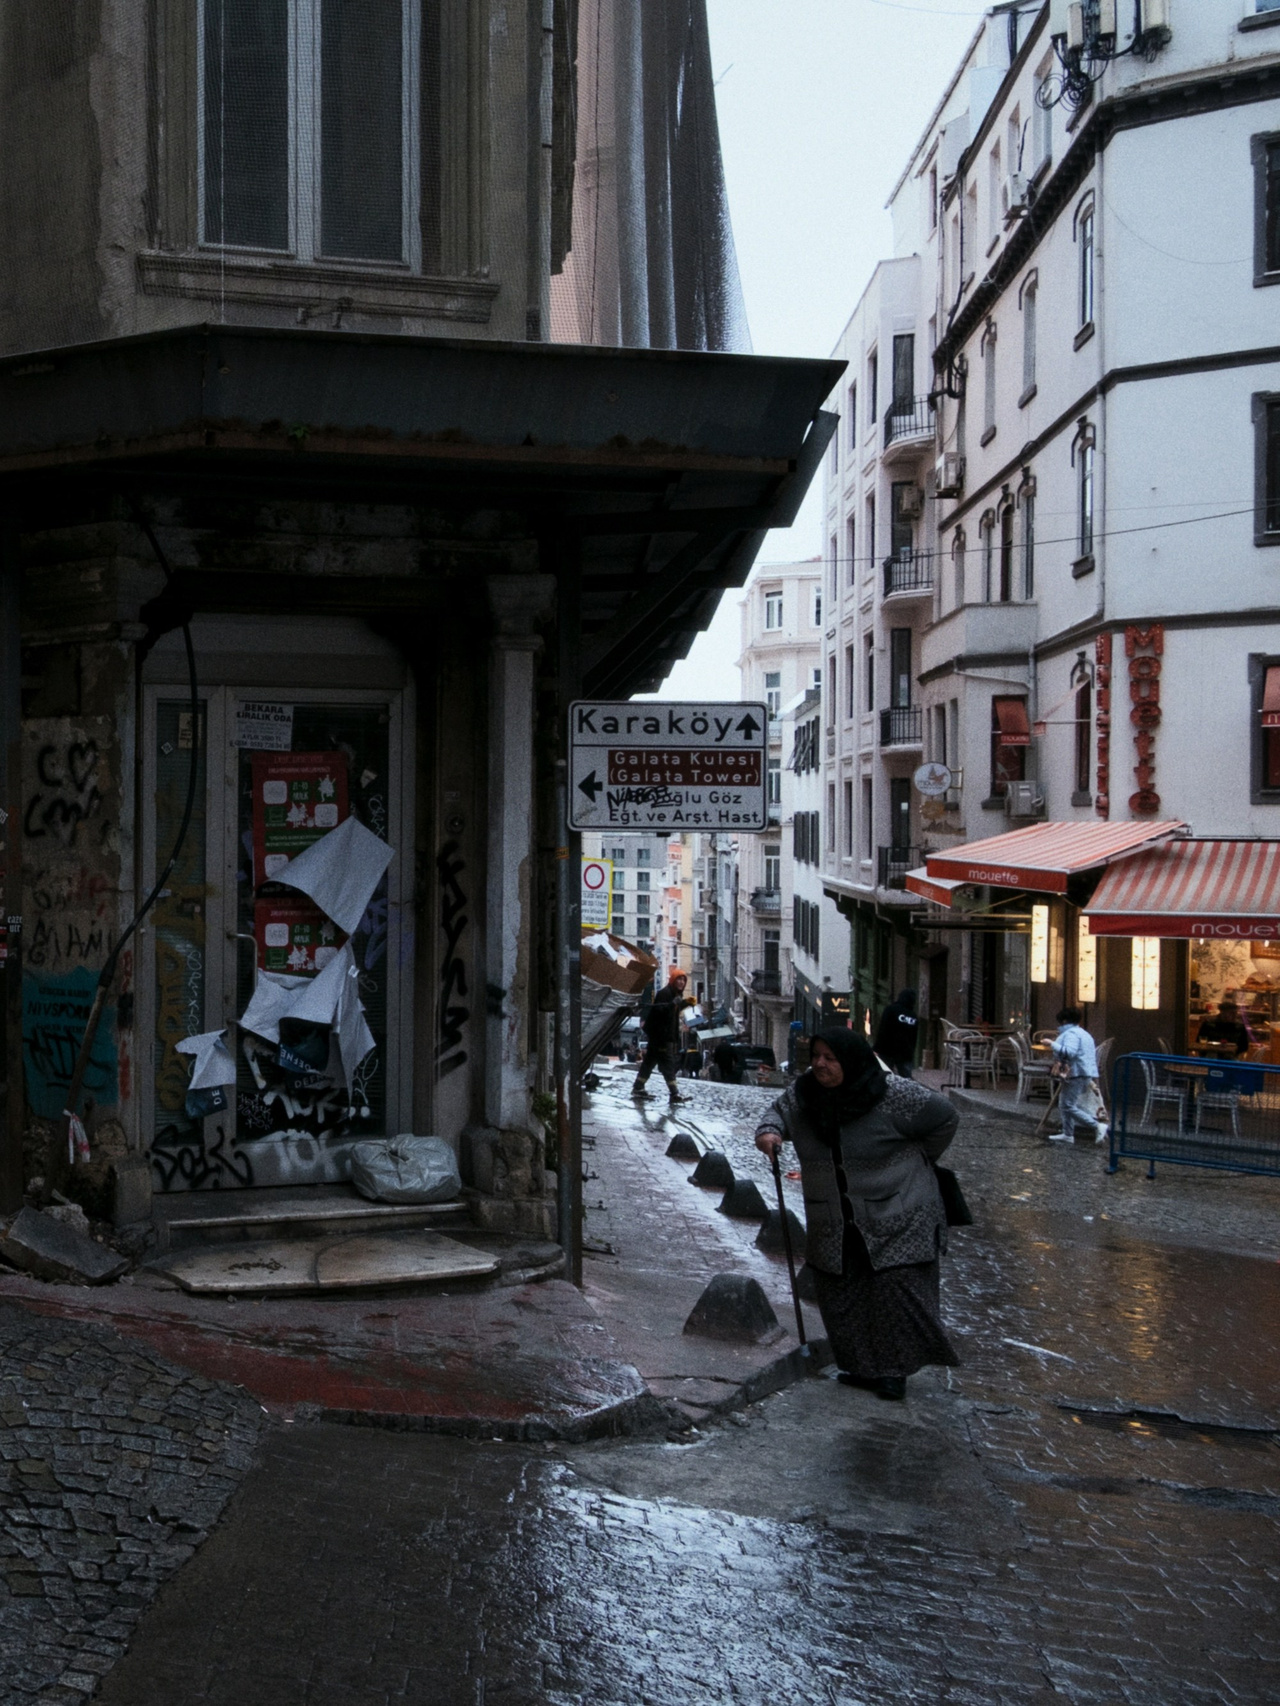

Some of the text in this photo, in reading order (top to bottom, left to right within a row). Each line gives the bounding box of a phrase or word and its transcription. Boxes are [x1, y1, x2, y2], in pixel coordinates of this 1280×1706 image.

[577, 708, 733, 742] Karaköy
[614, 751, 755, 766] Galata Kulesi
[609, 769, 760, 785] (Galata Tower)
[708, 791, 742, 805] Göz
[609, 809, 762, 825] Eğt. ve Arşt. Hast.
[968, 869, 1019, 885] mouette
